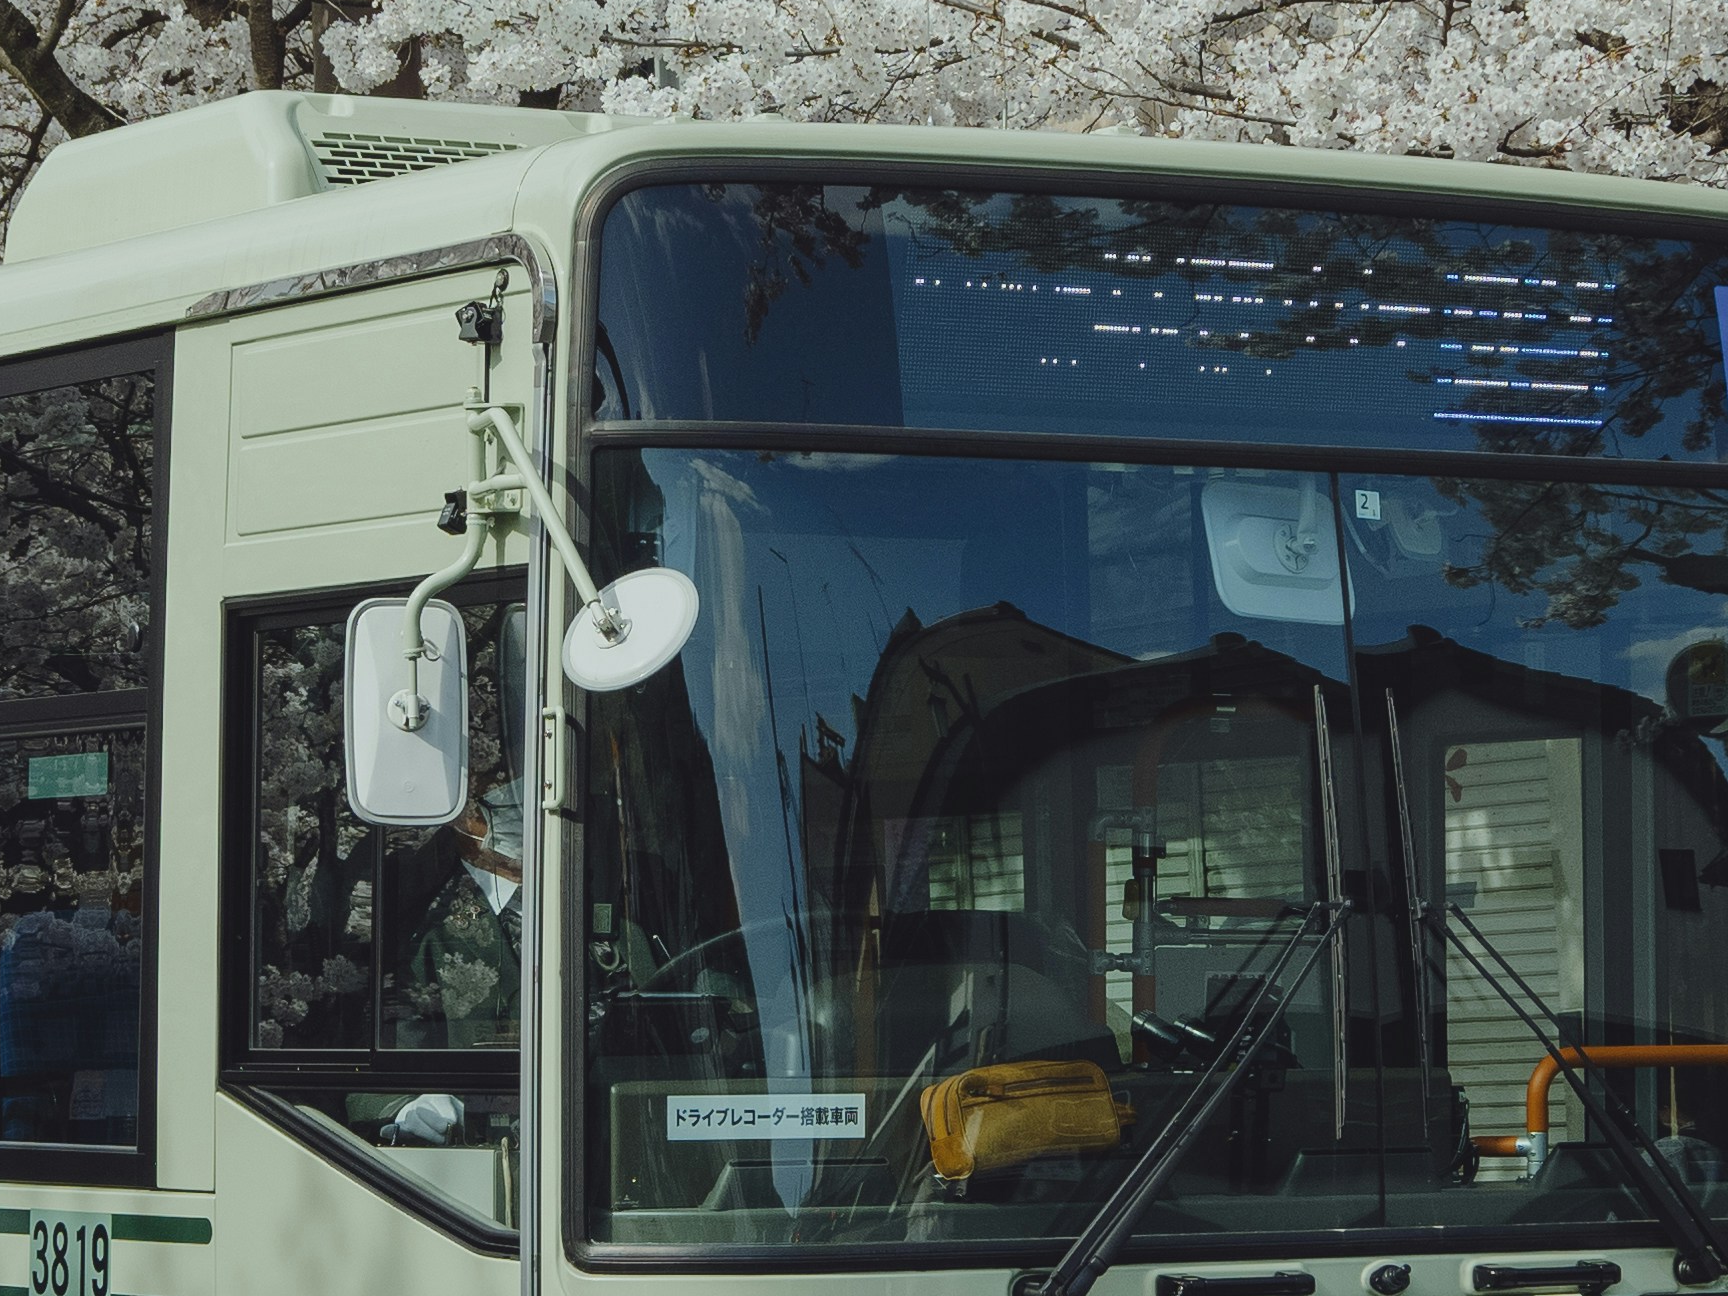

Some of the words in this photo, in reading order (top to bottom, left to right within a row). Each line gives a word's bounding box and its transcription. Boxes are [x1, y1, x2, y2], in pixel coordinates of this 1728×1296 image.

[675, 1106, 859, 1127] ドライブレコーダー搭載車両
